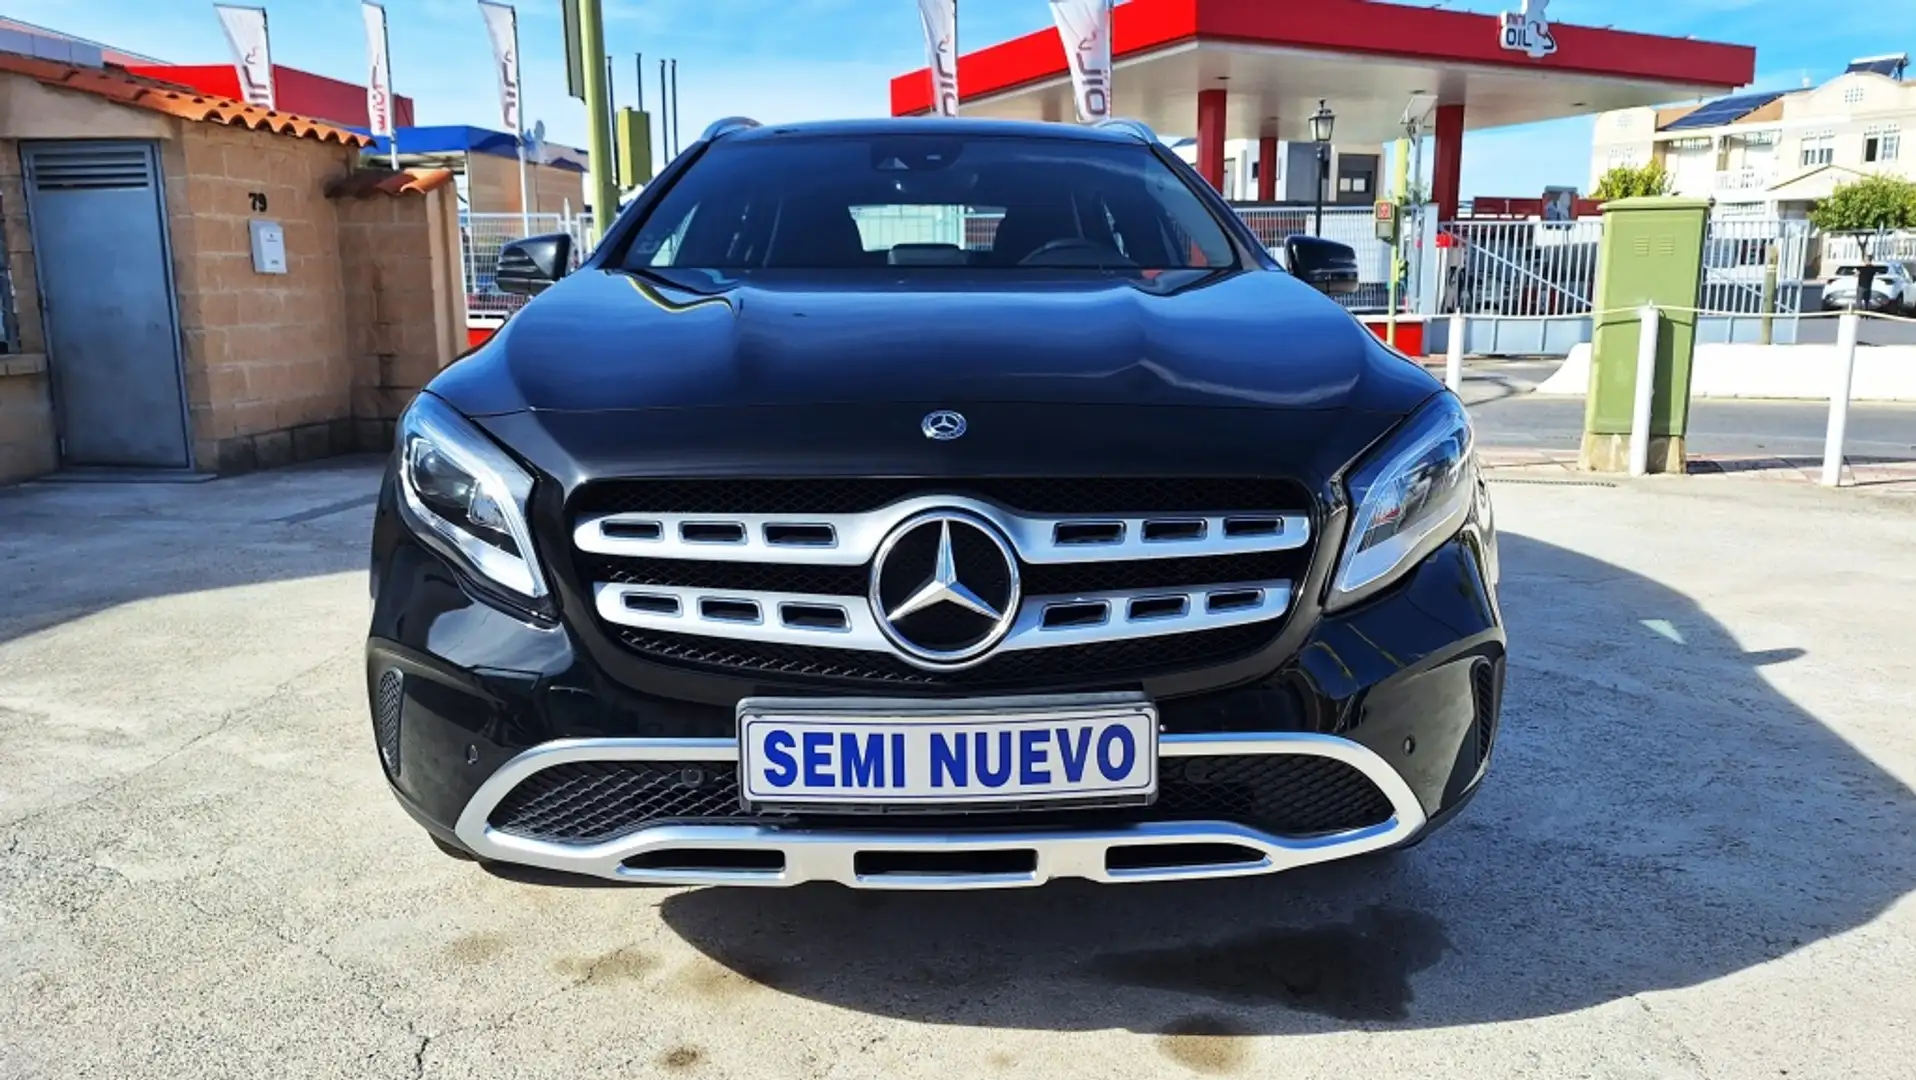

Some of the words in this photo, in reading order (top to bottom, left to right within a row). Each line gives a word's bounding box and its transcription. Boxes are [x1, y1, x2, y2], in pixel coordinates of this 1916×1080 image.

[1506, 28, 1532, 46] OIL
[248, 192, 267, 212] 79
[763, 729, 906, 788] SEMI
[930, 723, 1136, 788] NUEVO
